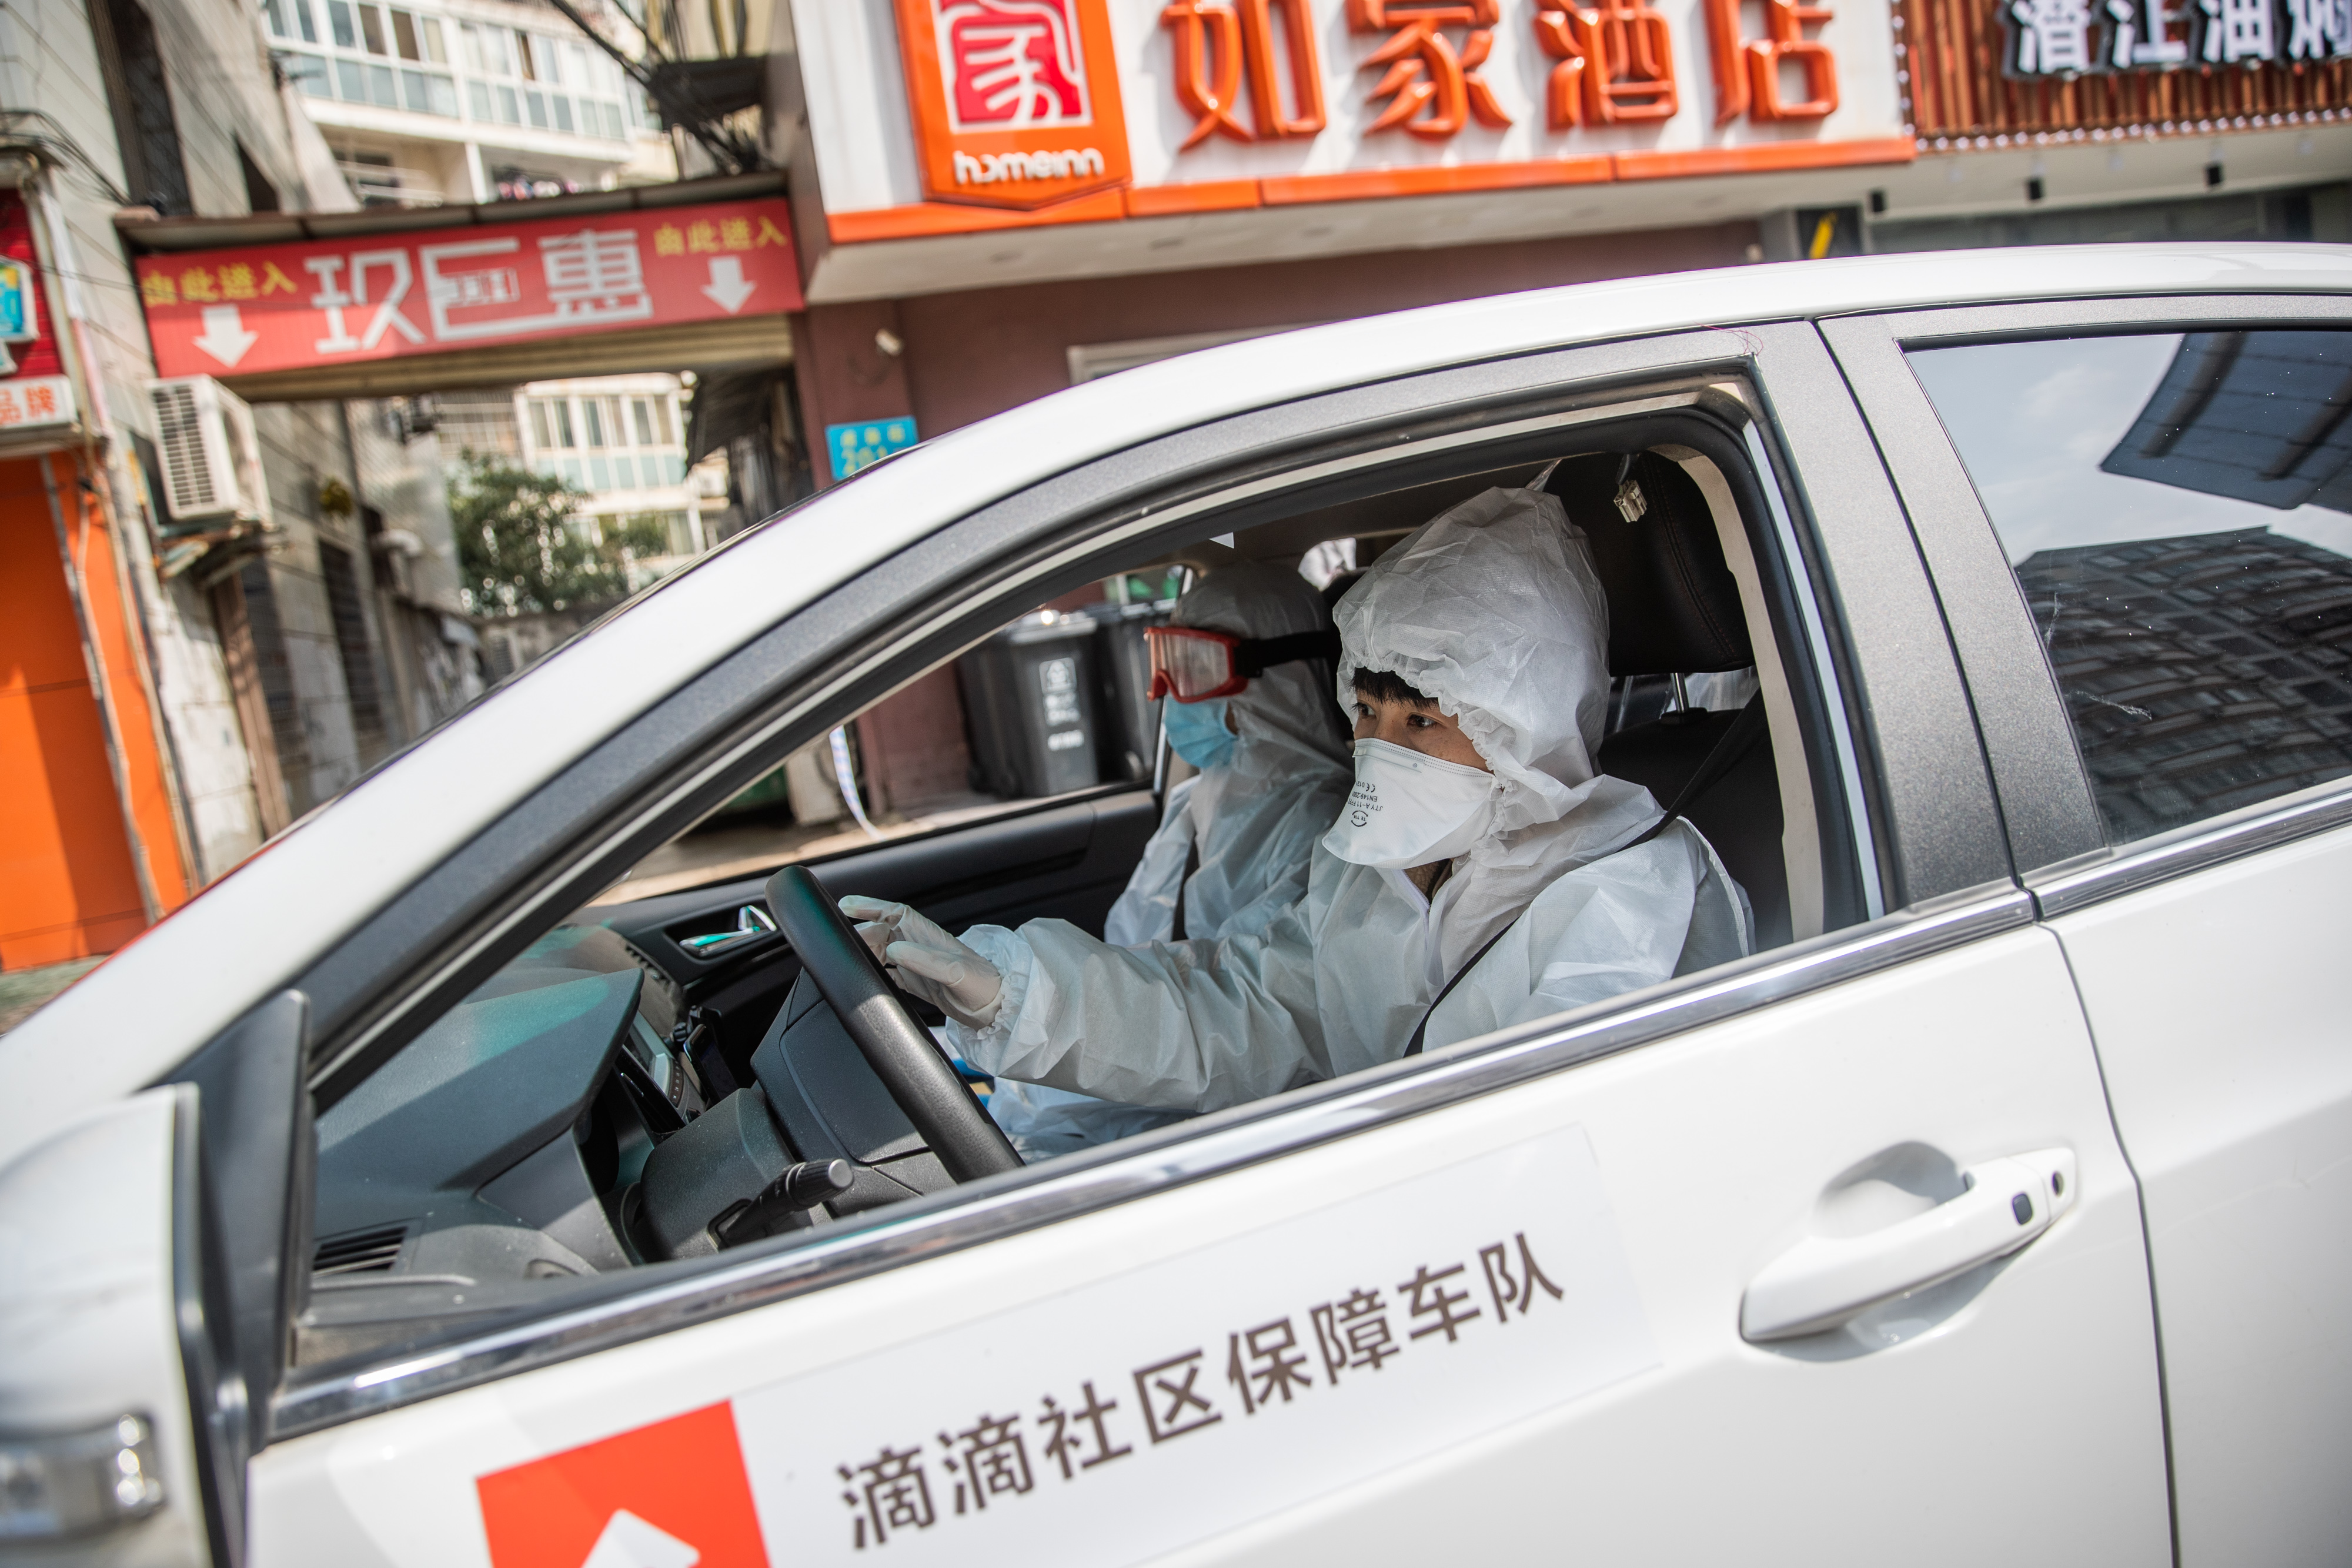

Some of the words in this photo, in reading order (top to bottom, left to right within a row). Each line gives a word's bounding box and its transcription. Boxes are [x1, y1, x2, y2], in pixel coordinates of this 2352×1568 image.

[1160, 0, 1839, 152] 如家酒店
[141, 260, 298, 307] 由此进入
[653, 215, 788, 258] 由此进入
[836, 1232, 1565, 1550] 滴滴社区保障车队
